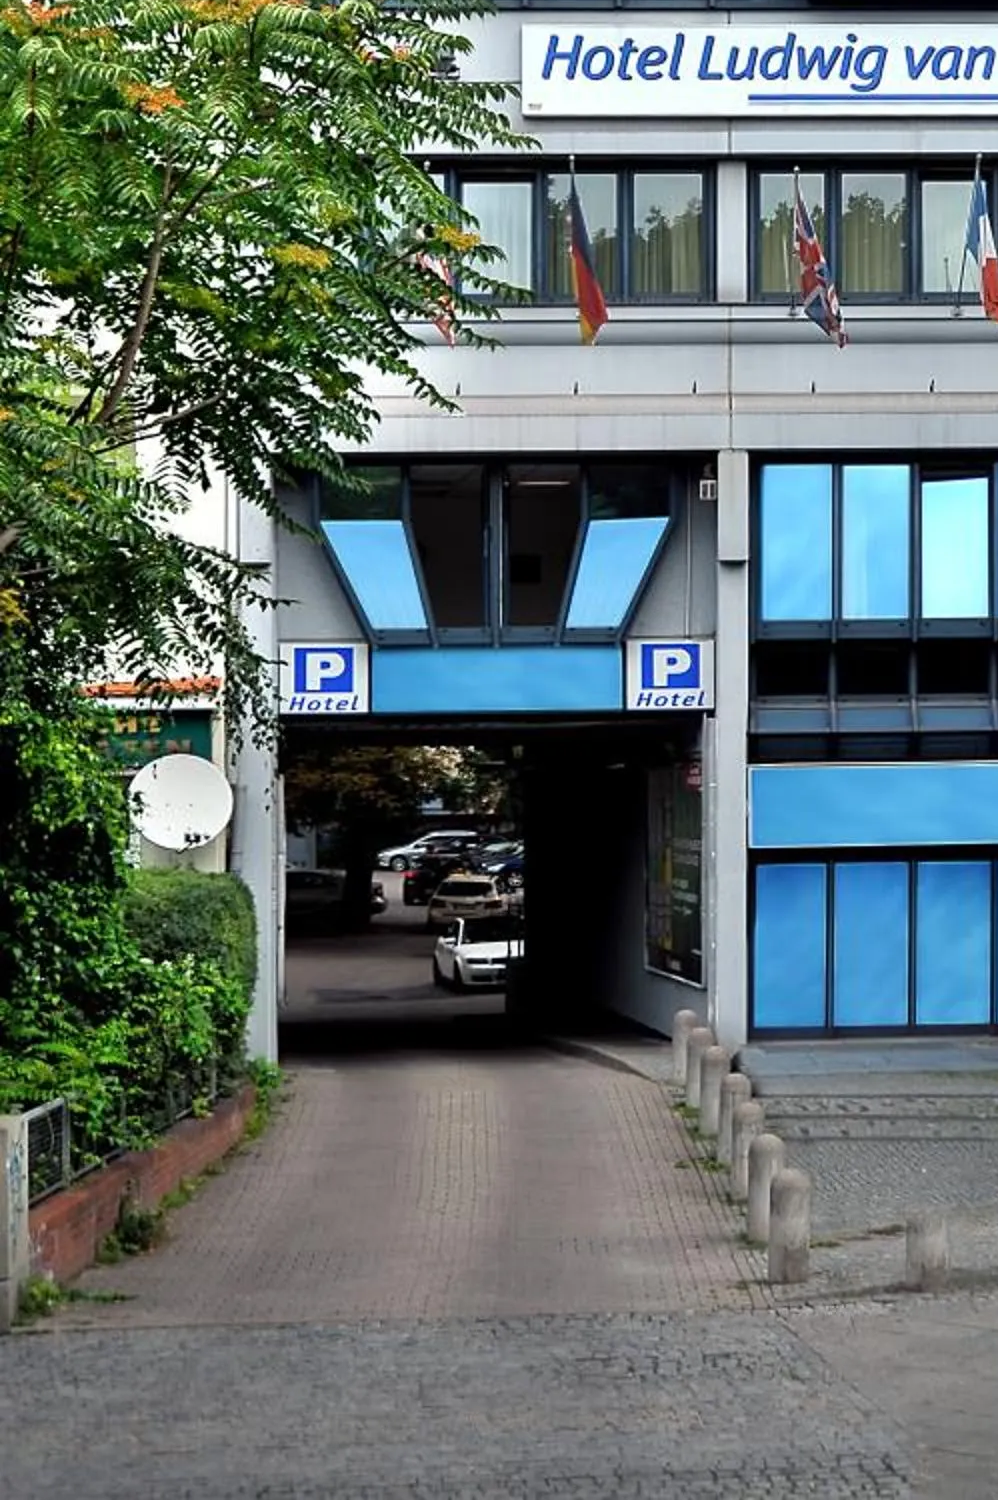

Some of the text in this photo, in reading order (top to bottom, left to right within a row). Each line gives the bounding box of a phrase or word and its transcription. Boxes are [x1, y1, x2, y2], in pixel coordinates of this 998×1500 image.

[541, 34, 685, 82] Hotel
[696, 33, 889, 92] Ludwig
[904, 44, 996, 81] van
[305, 653, 346, 690] P
[653, 648, 692, 687] P
[289, 695, 359, 711] Hotel
[637, 691, 705, 707] Hotel
